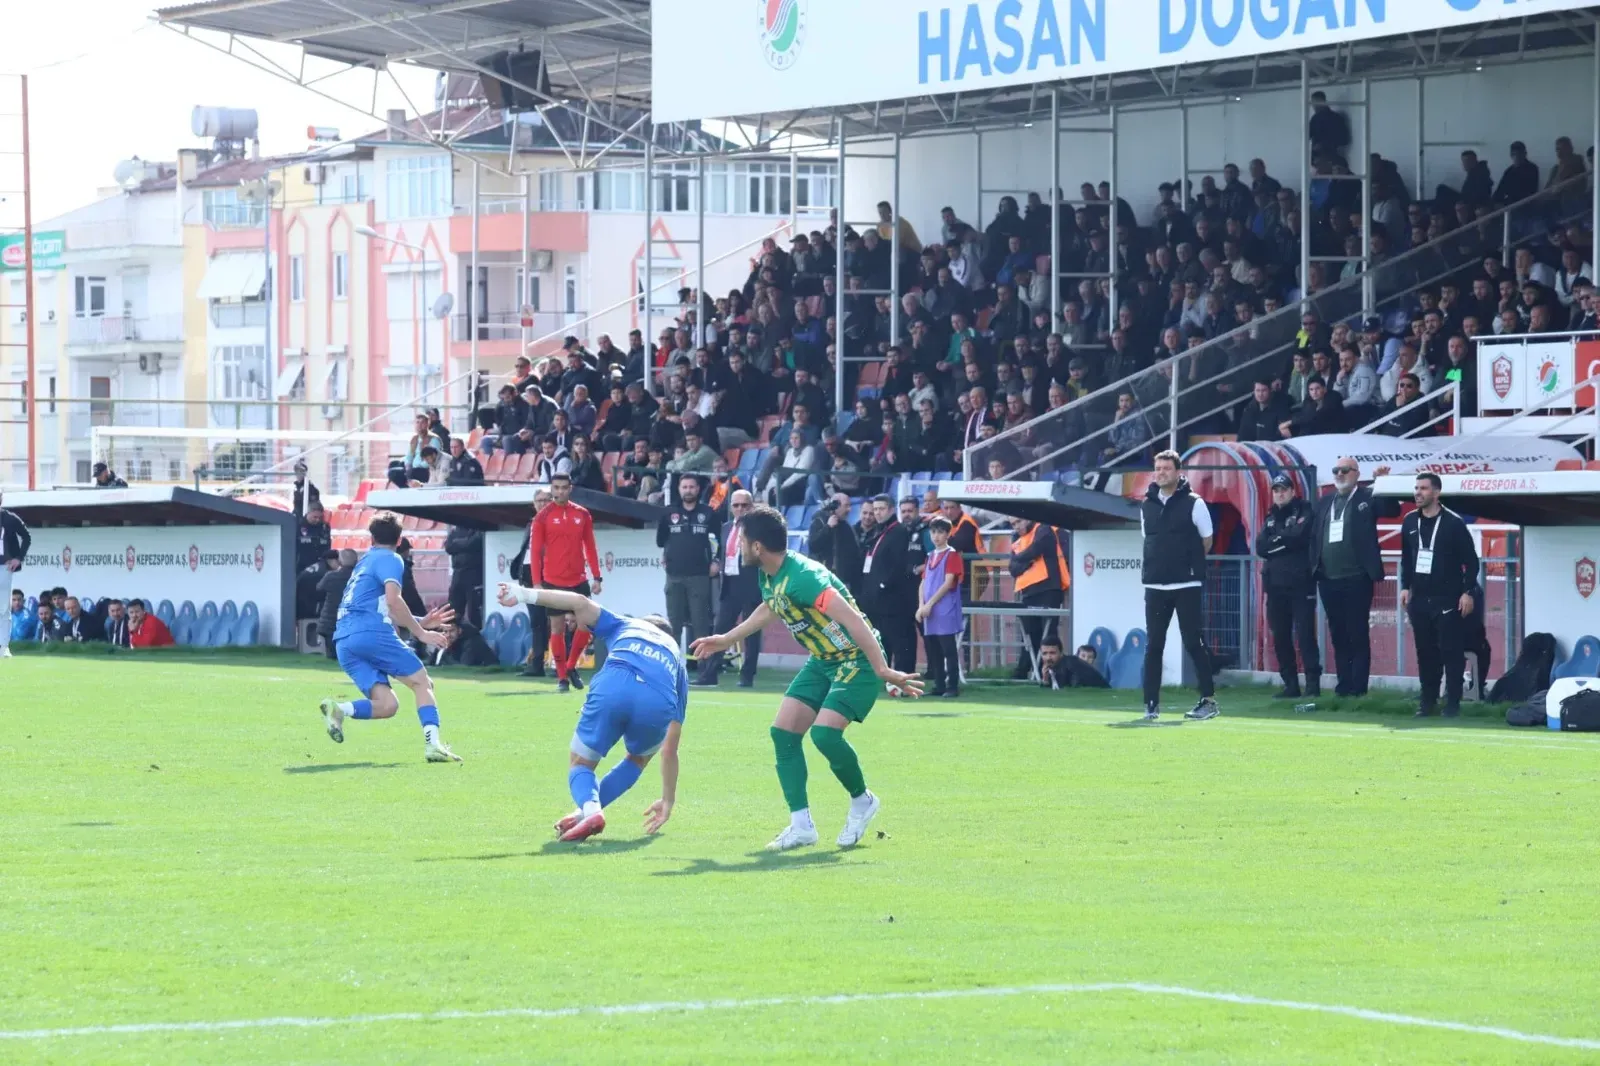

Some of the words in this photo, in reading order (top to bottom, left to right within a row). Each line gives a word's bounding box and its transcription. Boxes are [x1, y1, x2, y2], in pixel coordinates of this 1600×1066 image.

[918, 0, 1106, 84] HASAN
[1460, 480, 1517, 491] KEPEZSPOR
[75, 554, 112, 566] KEPEZSPOR
[136, 554, 174, 566] KEPEZSPOR
[200, 554, 239, 566] KEPEZSPOR
[614, 558, 649, 568] KEPEZSPOR
[1096, 558, 1142, 570] KEPEZSPOR
